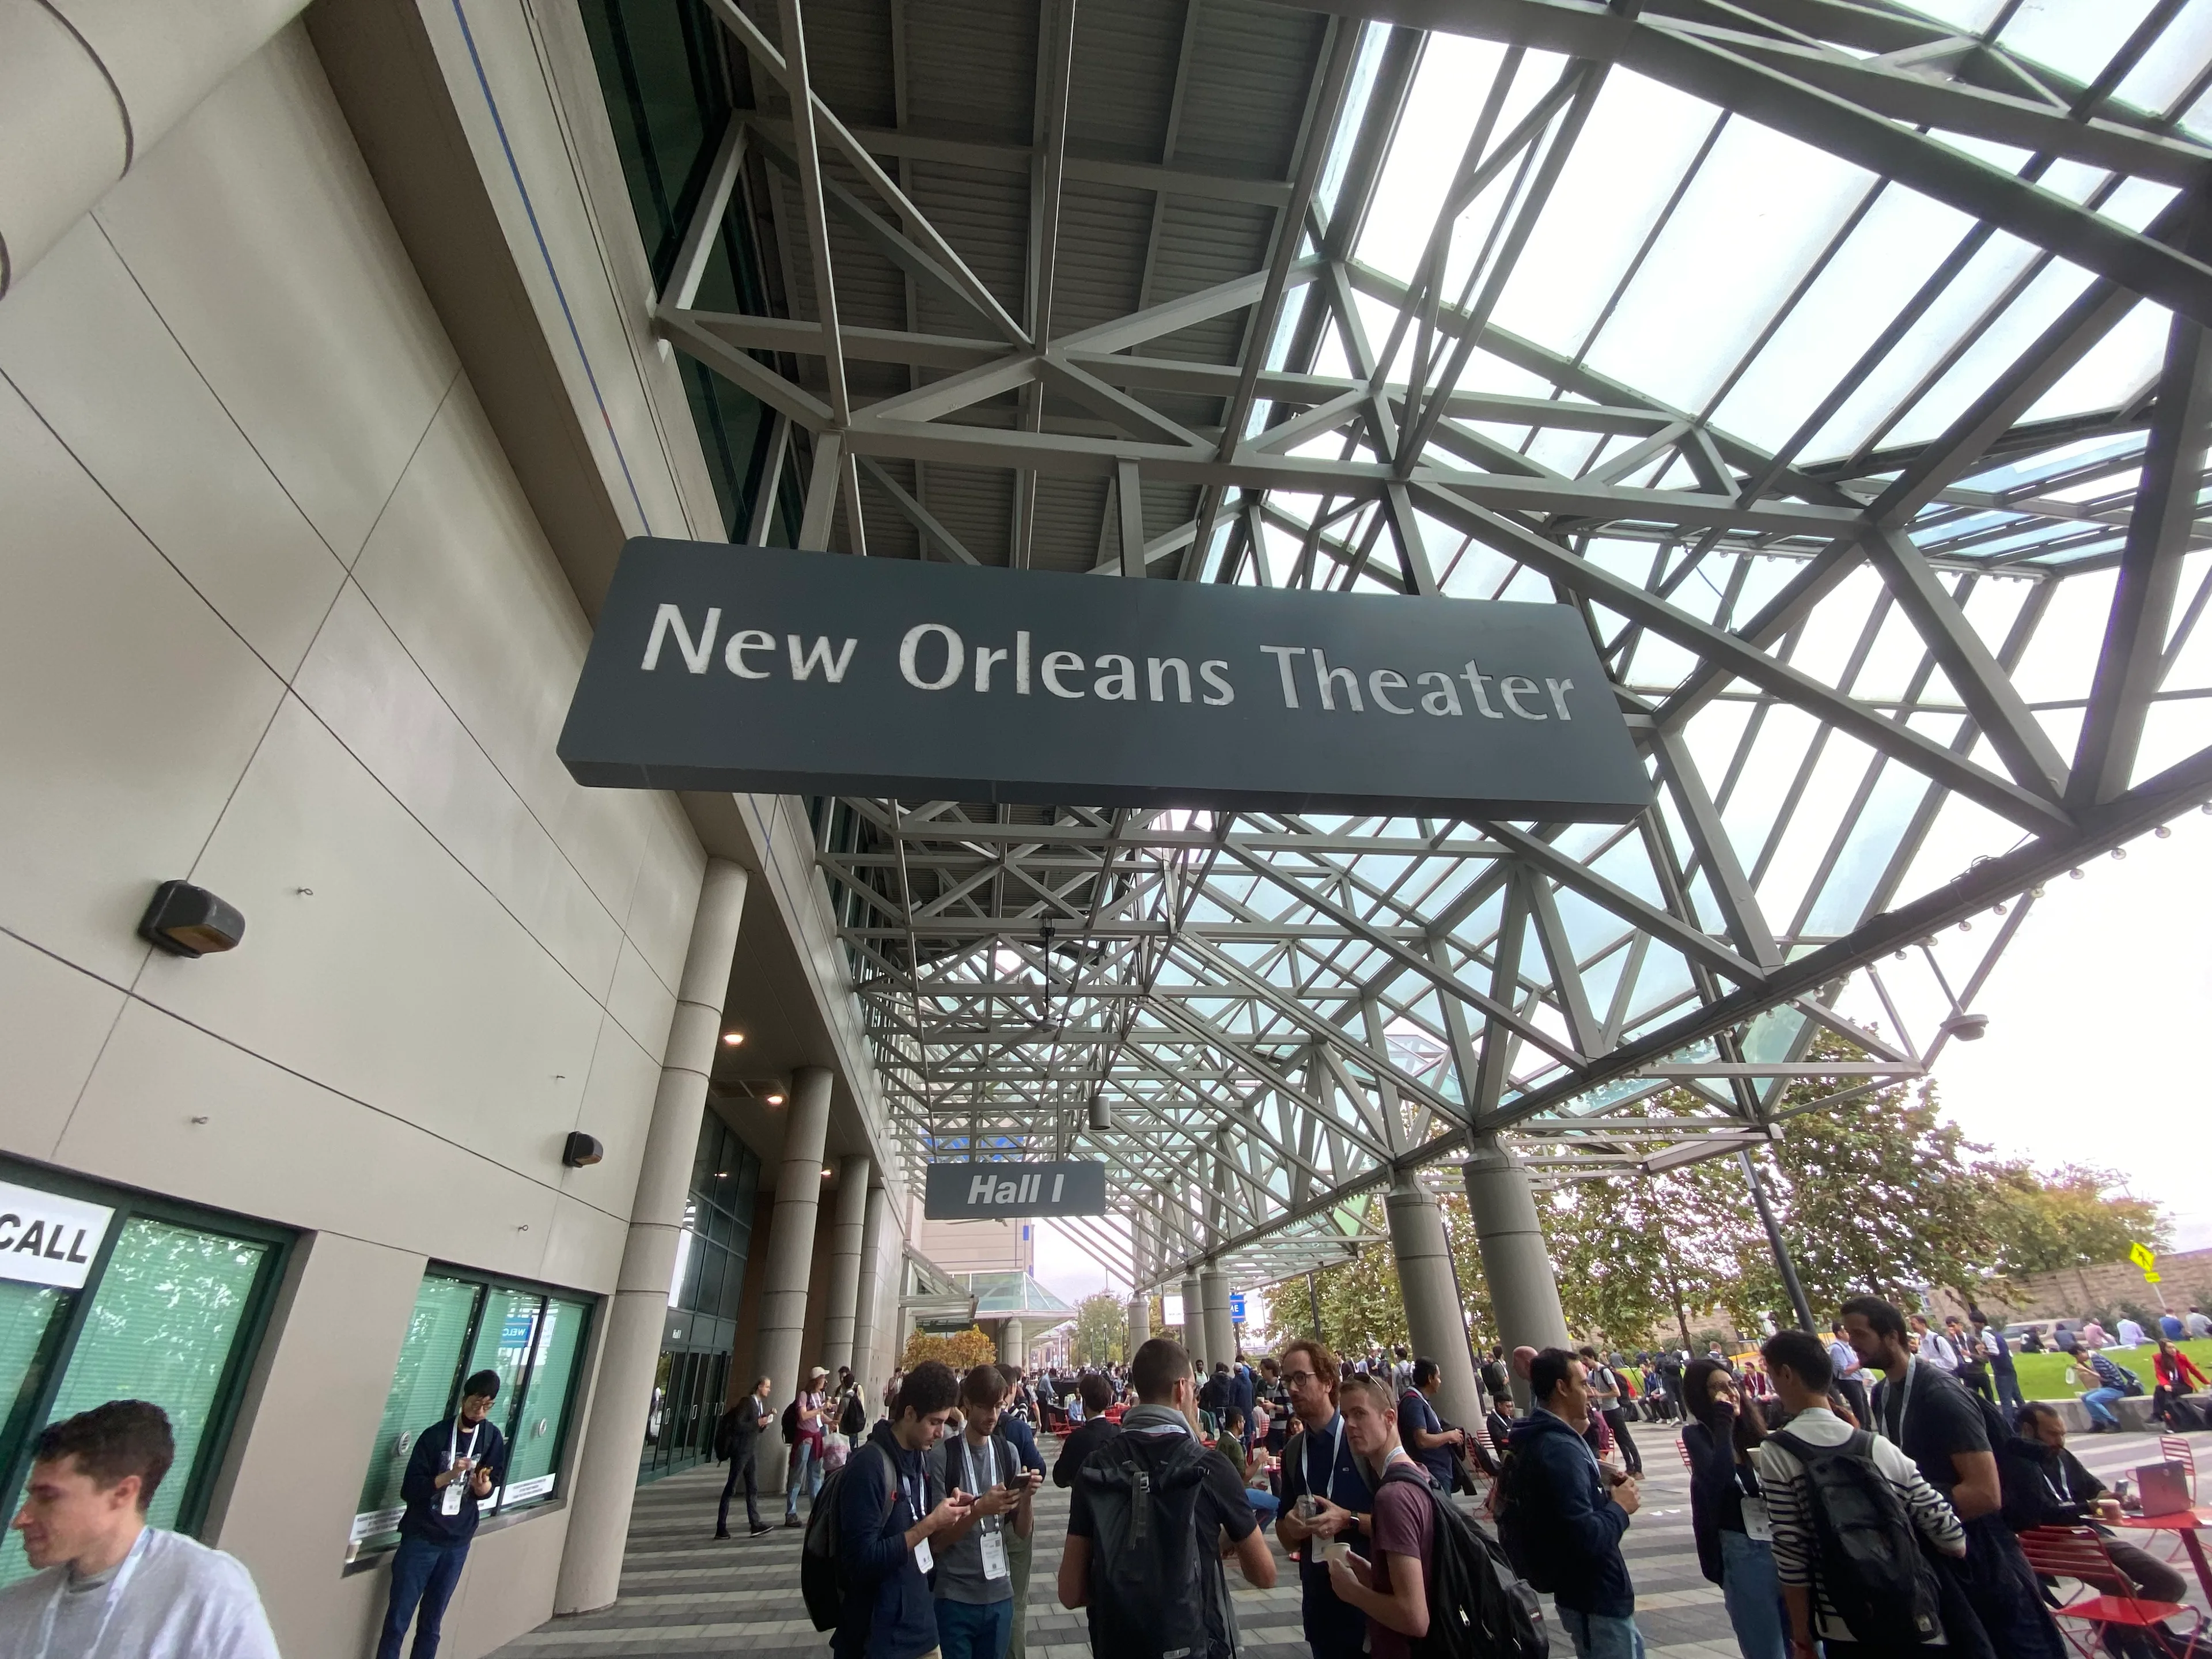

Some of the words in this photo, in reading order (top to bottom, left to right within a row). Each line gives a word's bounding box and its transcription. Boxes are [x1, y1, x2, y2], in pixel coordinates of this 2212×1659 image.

[641, 603, 858, 683] New
[899, 623, 1234, 706] Orleans
[1259, 644, 1575, 721] Theater
[967, 1174, 1041, 1204] Hall
[1051, 1174, 1065, 1202] I
[0, 1214, 88, 1263] CALL
